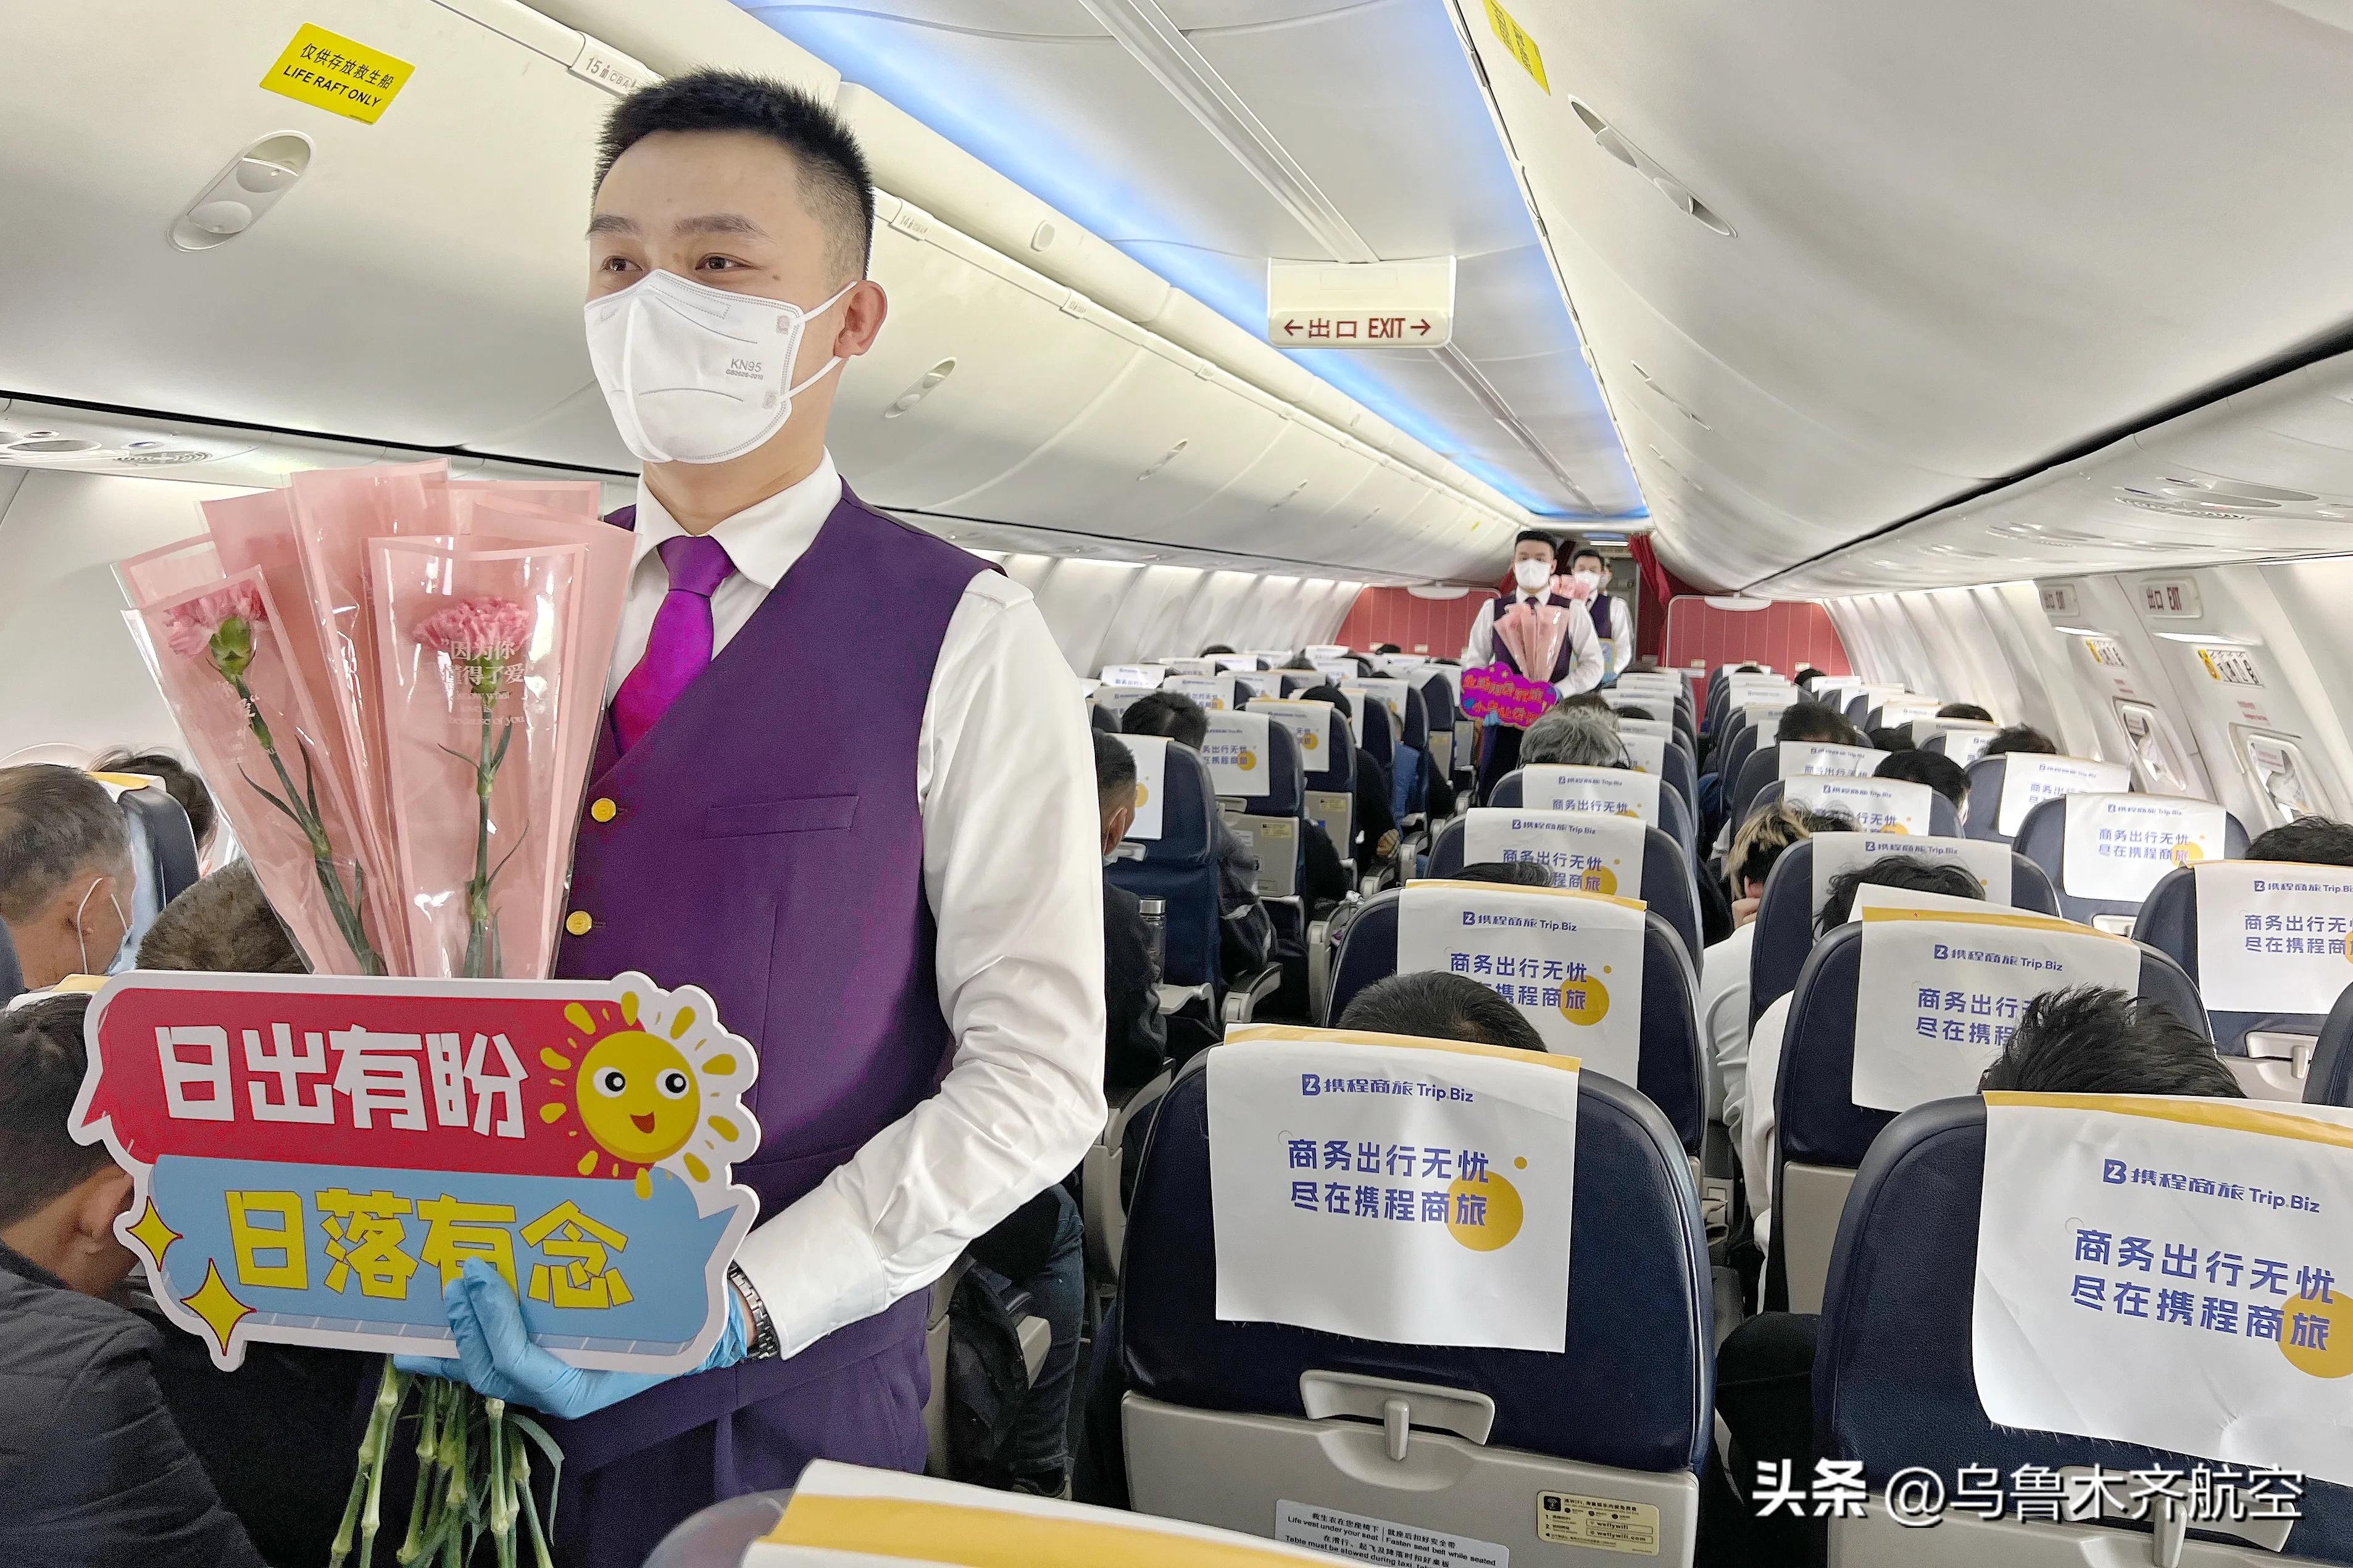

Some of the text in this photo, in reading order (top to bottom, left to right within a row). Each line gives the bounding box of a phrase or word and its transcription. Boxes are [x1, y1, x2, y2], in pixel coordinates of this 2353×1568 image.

[300, 43, 395, 90] 仅供存放救生船
[586, 57, 603, 74] 15
[283, 64, 383, 108] LIFE RAFT ONLY
[1309, 317, 1406, 339] 出口 EXIT
[730, 357, 762, 374] KN95
[2146, 585, 2183, 611] 出口 EXIT
[451, 639, 516, 661] 因为你
[2099, 828, 2190, 845] 商务出行无忧
[1539, 919, 1578, 932] Trip.Biz
[1450, 952, 1588, 984] 商务出行无忧
[2020, 956, 2064, 972] Trip.Biz
[1480, 981, 1587, 1011] 携程商旅
[154, 1021, 529, 1140] 日出有盼
[1323, 1077, 1415, 1096] 携程商旅
[1416, 1082, 1475, 1103] Trip.Biz
[1288, 1139, 1491, 1184] 商务出行无忧
[1290, 1180, 1489, 1227] 尽在携程商旅
[2130, 1168, 2246, 1201] 携程商旅
[2248, 1187, 2322, 1214] Trip.Biz
[224, 1187, 635, 1311] 日落有念
[2074, 1229, 2336, 1305] 商务出行无忧
[2070, 1273, 2331, 1353] 尽在携程商旅
[1288, 1515, 1302, 1525] Life
[1320, 1524, 1343, 1533] under
[1343, 1529, 1360, 1538] your
[1285, 1534, 1307, 1545] Table
[1308, 1540, 1328, 1550] must
[1328, 1544, 1339, 1552] be
[1370, 1553, 1396, 1566] during
